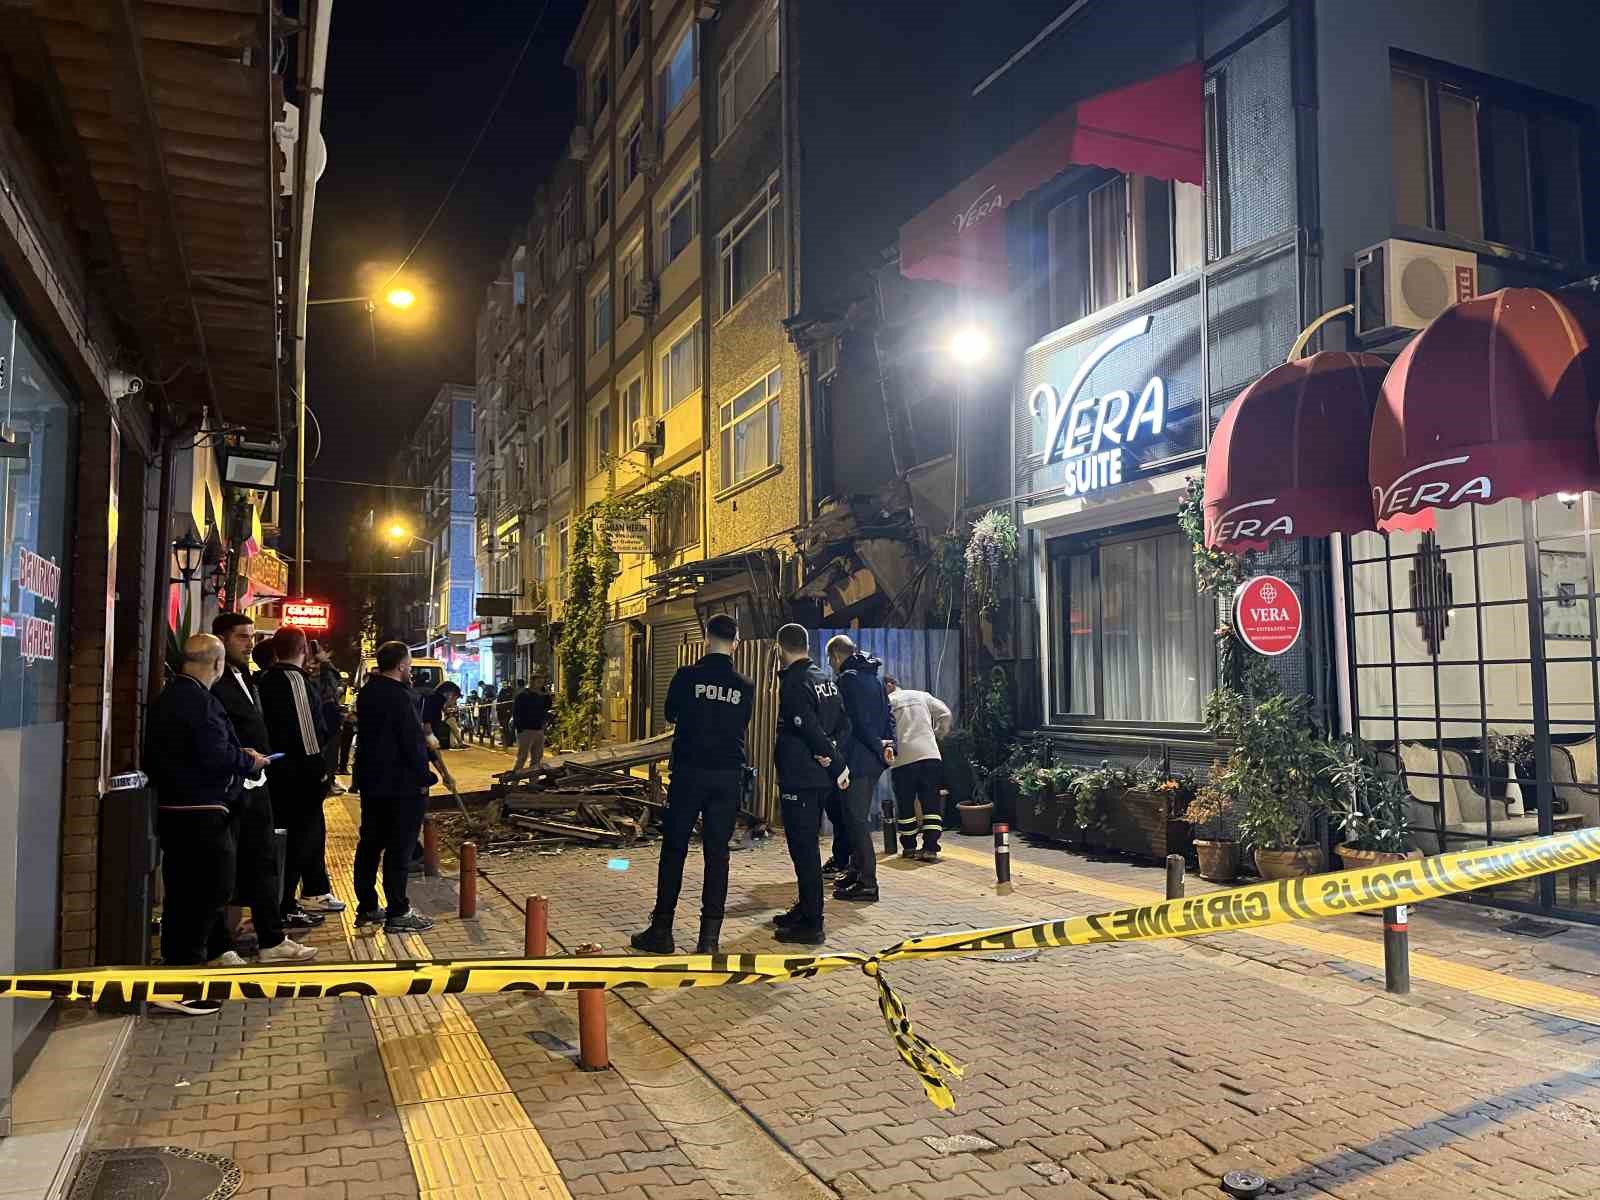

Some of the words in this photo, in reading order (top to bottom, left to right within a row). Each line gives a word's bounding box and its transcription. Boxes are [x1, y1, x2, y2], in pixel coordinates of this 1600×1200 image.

[953, 184, 1003, 233] VERA
[1459, 269, 1471, 304] STEL
[1028, 314, 1166, 464] VERA
[1063, 447, 1122, 497] SUITE
[1371, 455, 1492, 515] VERA
[1250, 607, 1290, 621] VERA
